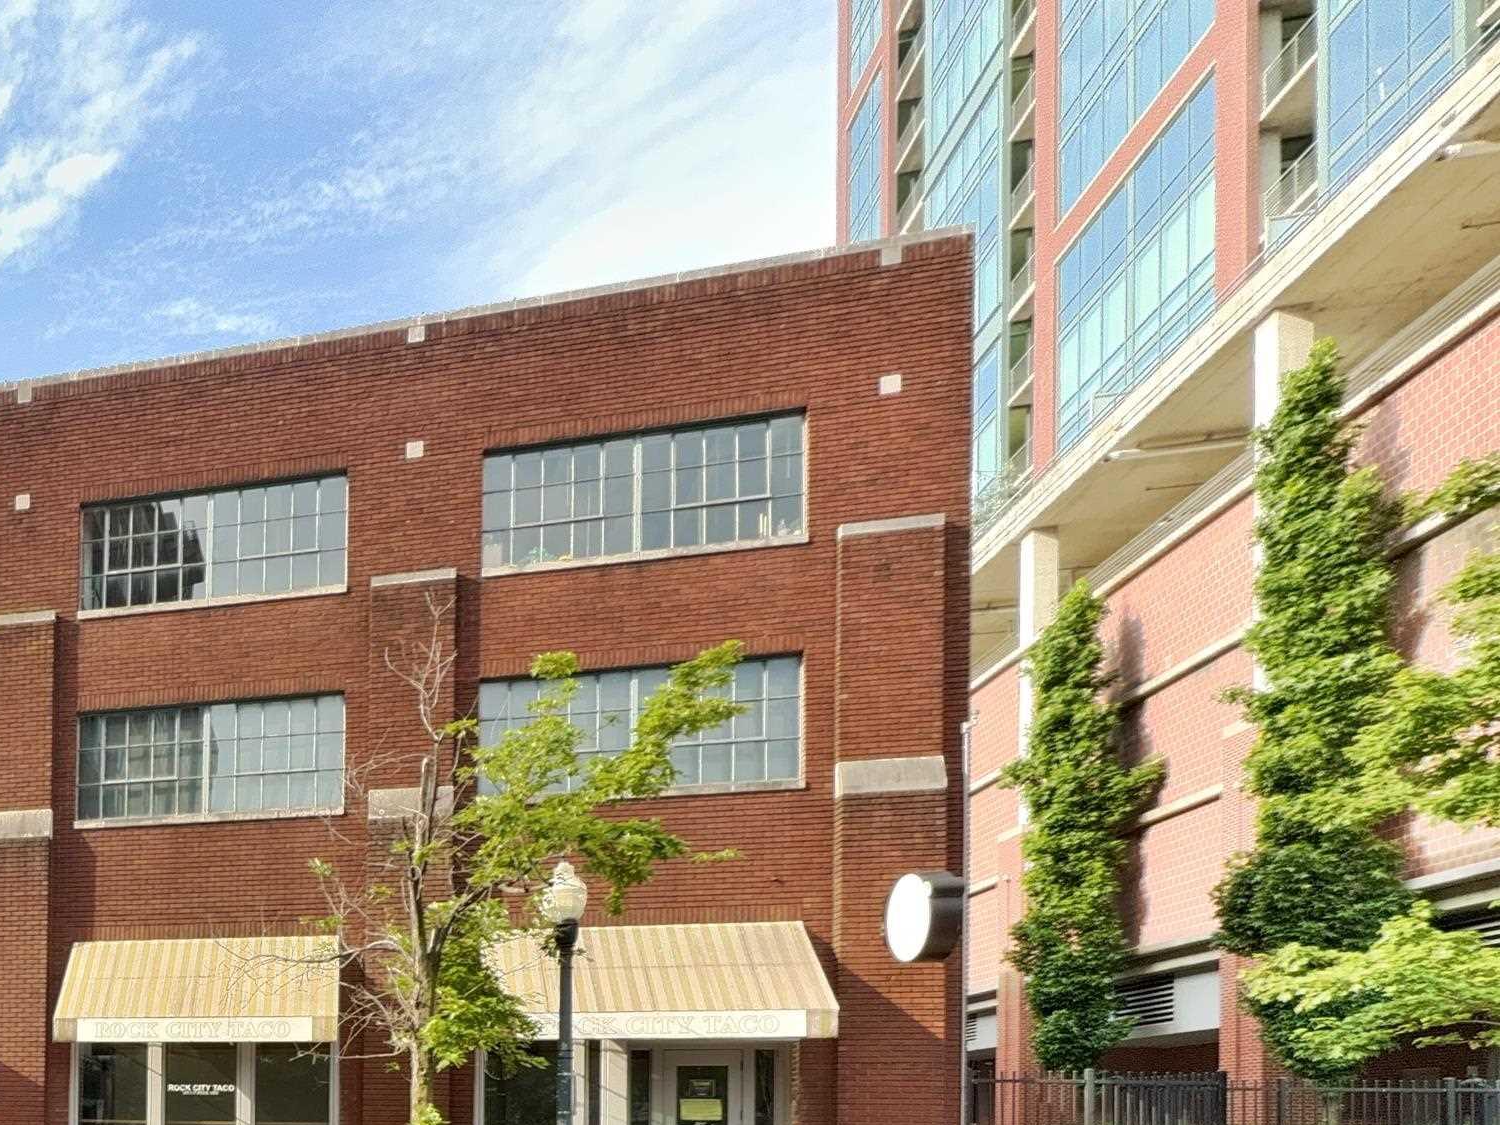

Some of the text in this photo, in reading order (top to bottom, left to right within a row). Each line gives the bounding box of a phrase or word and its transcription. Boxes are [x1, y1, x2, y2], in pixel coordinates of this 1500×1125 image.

[93, 1020, 292, 1039] ROCK CITY TACO
[626, 1015, 699, 1035] CITY
[703, 1014, 780, 1034] TACO
[167, 1084, 235, 1092] ROCK CITY TACO
